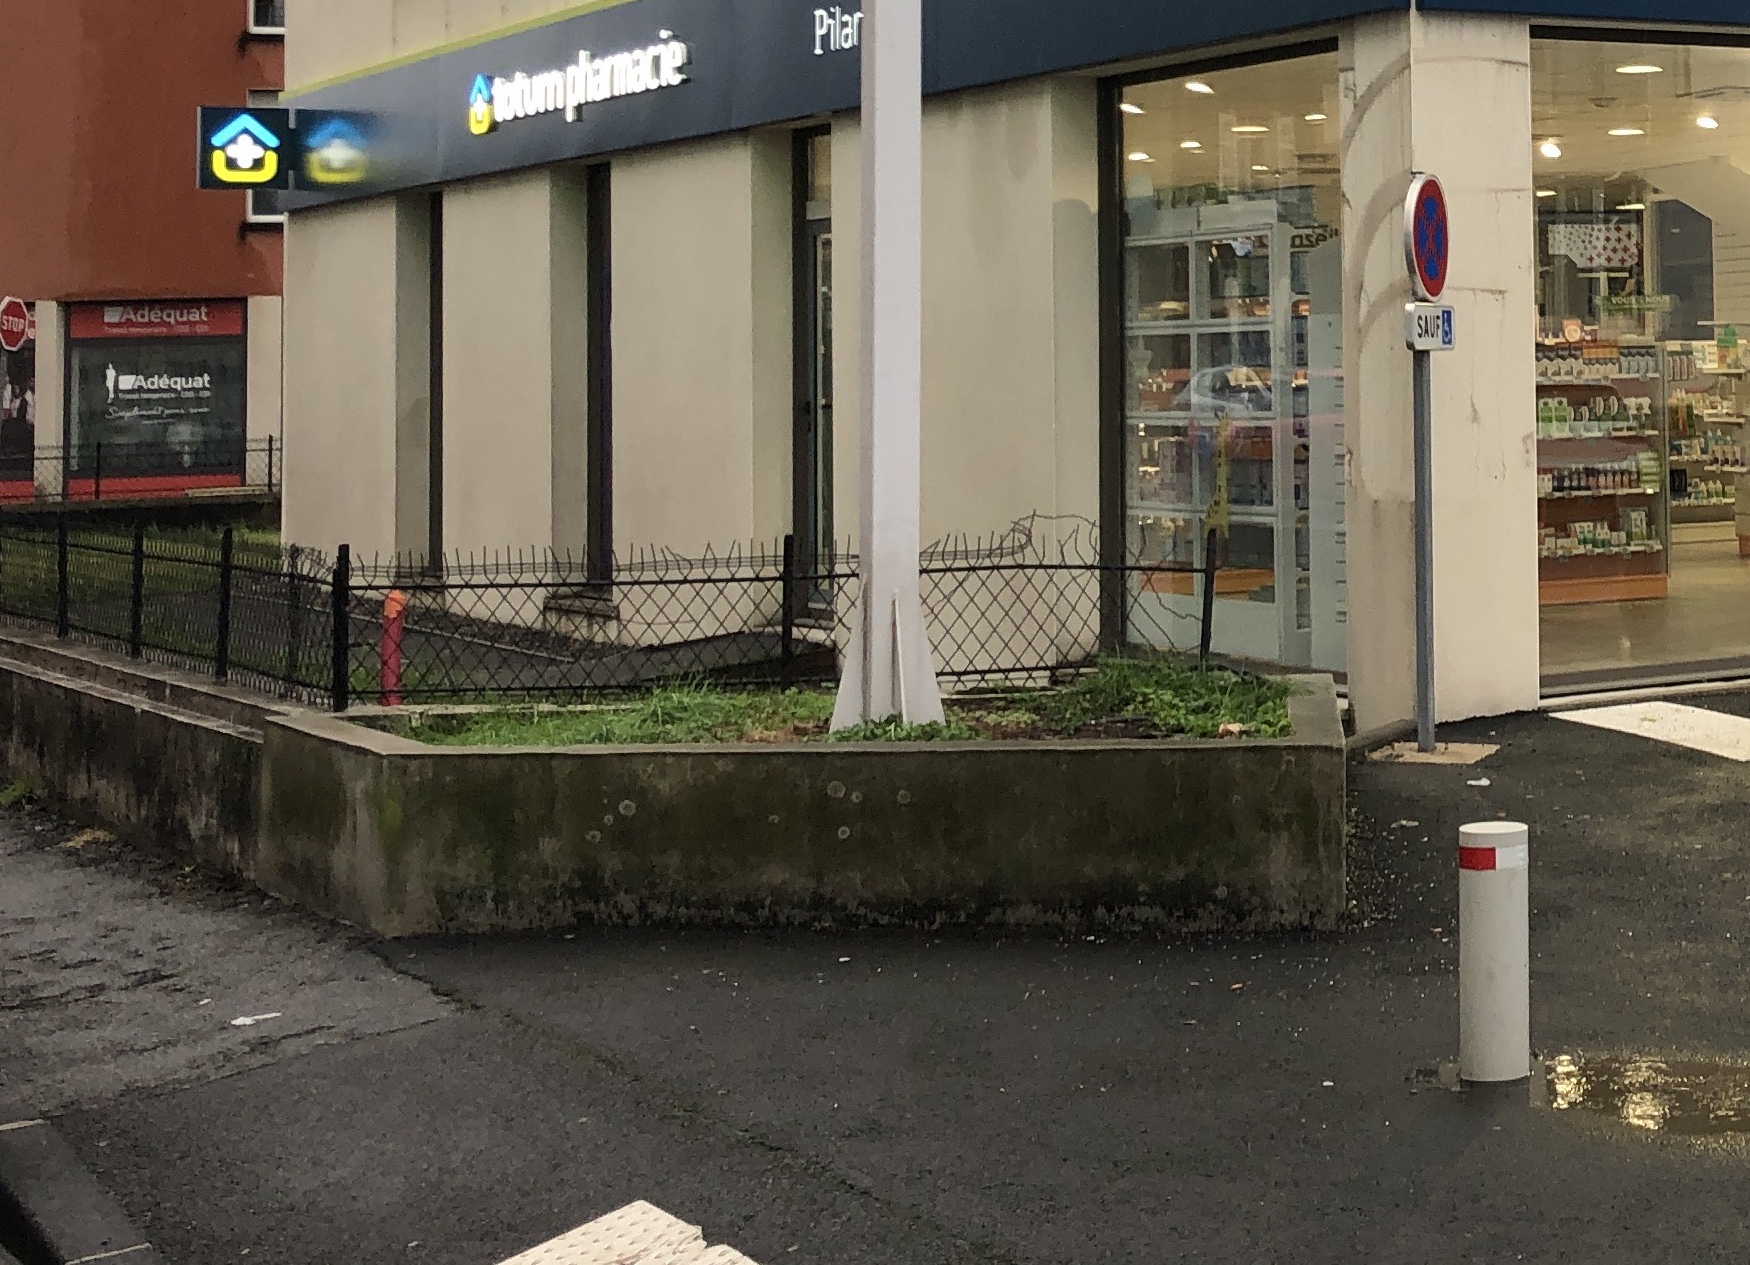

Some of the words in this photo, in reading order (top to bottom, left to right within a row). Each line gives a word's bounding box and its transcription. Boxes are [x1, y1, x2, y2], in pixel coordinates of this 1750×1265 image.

[813, 7, 862, 55] Pilar
[492, 70, 565, 121] totum
[565, 29, 688, 122] pharmacie
[2, 314, 25, 332] STOP
[121, 305, 208, 325] Adéquat
[1417, 315, 1440, 338] SAUF
[133, 372, 211, 392] Adéquat
